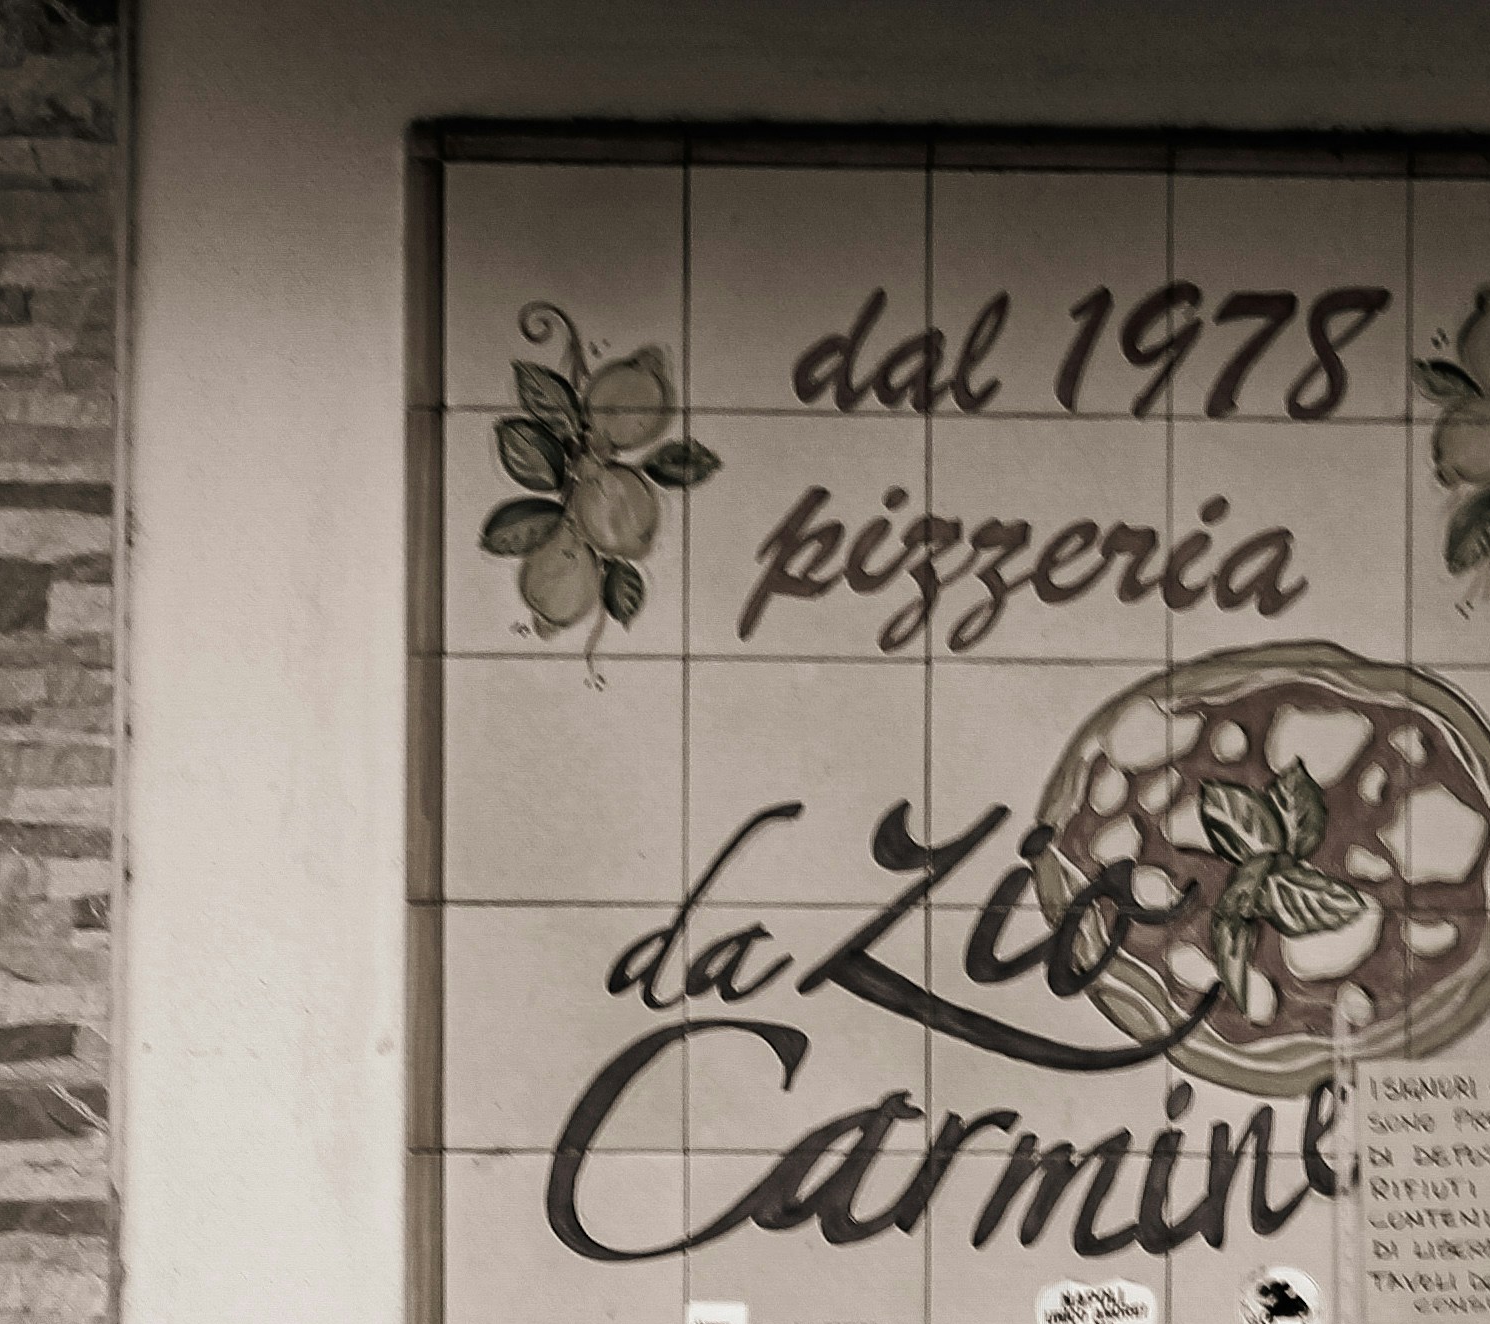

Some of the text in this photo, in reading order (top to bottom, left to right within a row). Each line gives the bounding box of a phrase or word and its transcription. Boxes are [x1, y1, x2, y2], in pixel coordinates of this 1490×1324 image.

[792, 283, 1392, 422] dal 1978
[736, 487, 1308, 652] pizzeria
[607, 801, 1221, 1071] da Zio
[546, 1018, 1358, 1263] Carmine
[1367, 1112, 1436, 1134] SONO
[1369, 1176, 1477, 1202] RIFIUTI
[1367, 1270, 1458, 1293] TAVOLI
